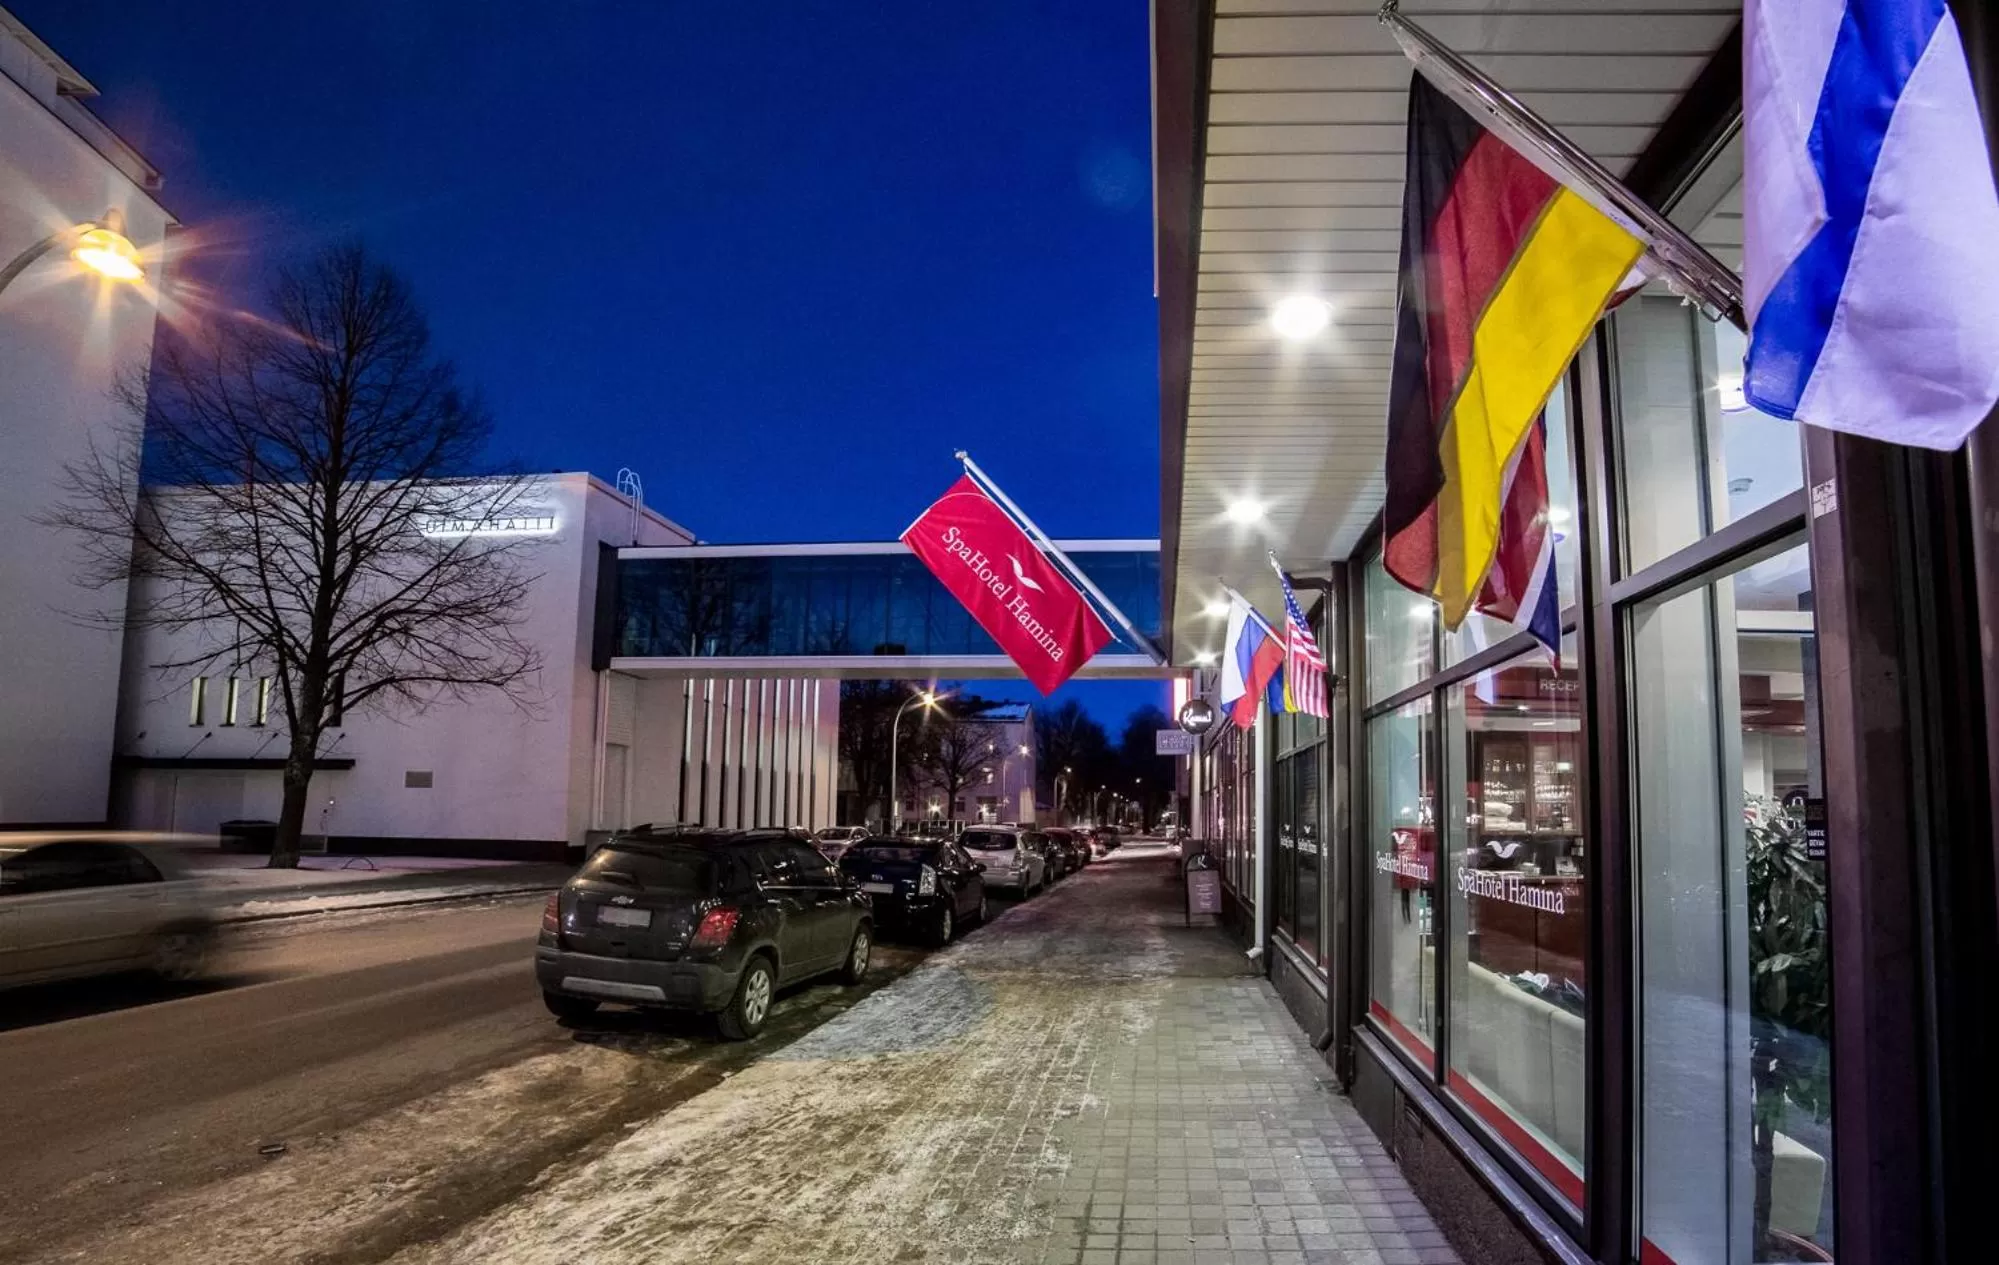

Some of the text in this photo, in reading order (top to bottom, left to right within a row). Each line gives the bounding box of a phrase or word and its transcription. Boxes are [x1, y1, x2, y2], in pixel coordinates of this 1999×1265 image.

[941, 526, 1065, 662] SpaHotel Hamina
[1376, 850, 1429, 880] SpaHotel Hamina
[1458, 867, 1506, 900] SpaHotel
[1509, 876, 1565, 914] Hamina
